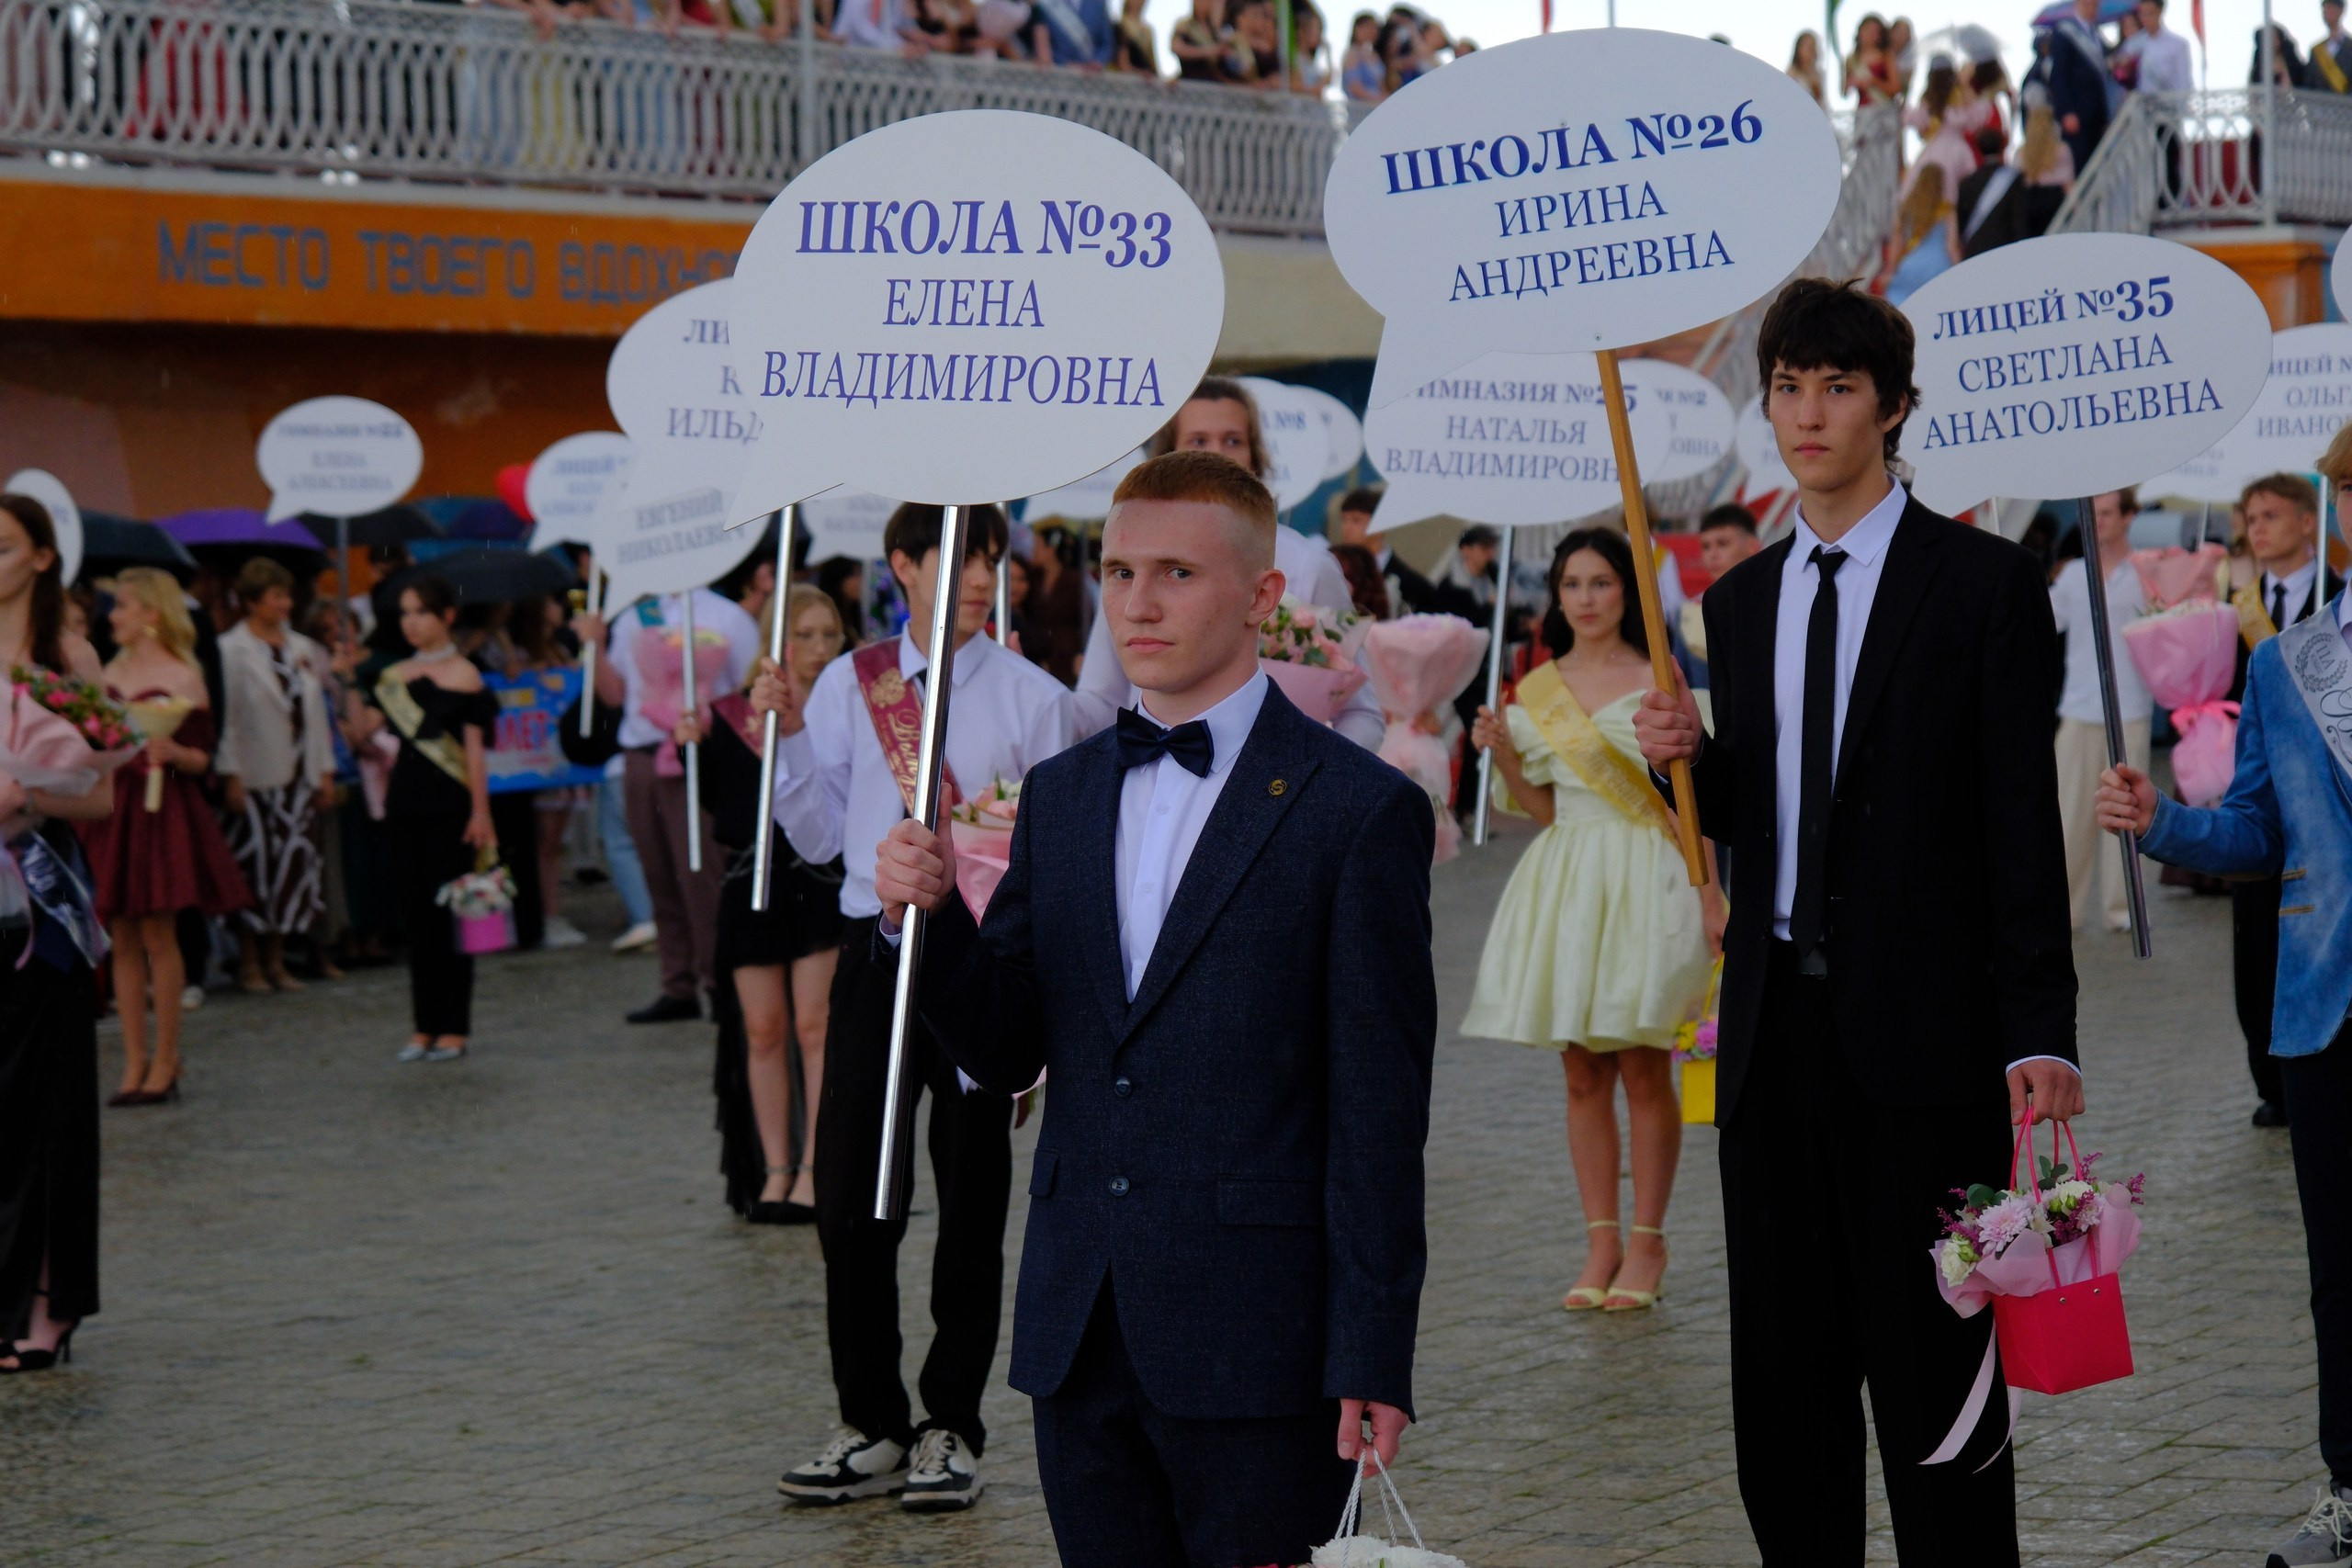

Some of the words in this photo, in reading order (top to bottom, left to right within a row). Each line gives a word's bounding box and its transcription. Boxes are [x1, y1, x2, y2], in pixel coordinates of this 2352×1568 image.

[1381, 123, 1618, 195] ШКОЛА
[1625, 99, 1763, 160] №26
[796, 199, 1024, 255] ШКОЛА
[1036, 199, 1172, 268] №33
[1495, 180, 1668, 238] ИРИНА
[157, 220, 331, 290] МЕСТО
[358, 229, 535, 299] ТВОЕГО
[559, 241, 741, 306] ВДОХНО
[1449, 229, 1736, 302] АНДРЕЕВНА
[882, 278, 1046, 328] ЕЛЕНА
[1933, 288, 2067, 341] ЛИЦЕЙ
[2075, 275, 2175, 322] №35
[760, 350, 1165, 411] ВЛАДИМИРОВНА
[1416, 378, 1557, 403] ИМНАЗИЯ
[1959, 333, 2174, 392] СВЕТЛАНА
[1923, 378, 2224, 450] АНАТОЛЬЕВНА
[2286, 383, 2352, 409] ОЛЬГ
[1445, 415, 1588, 446] НАТАЛЬЯ
[2256, 415, 2348, 438] ИВАНО
[1385, 447, 1644, 483] ВЛАДИМИРОВН
